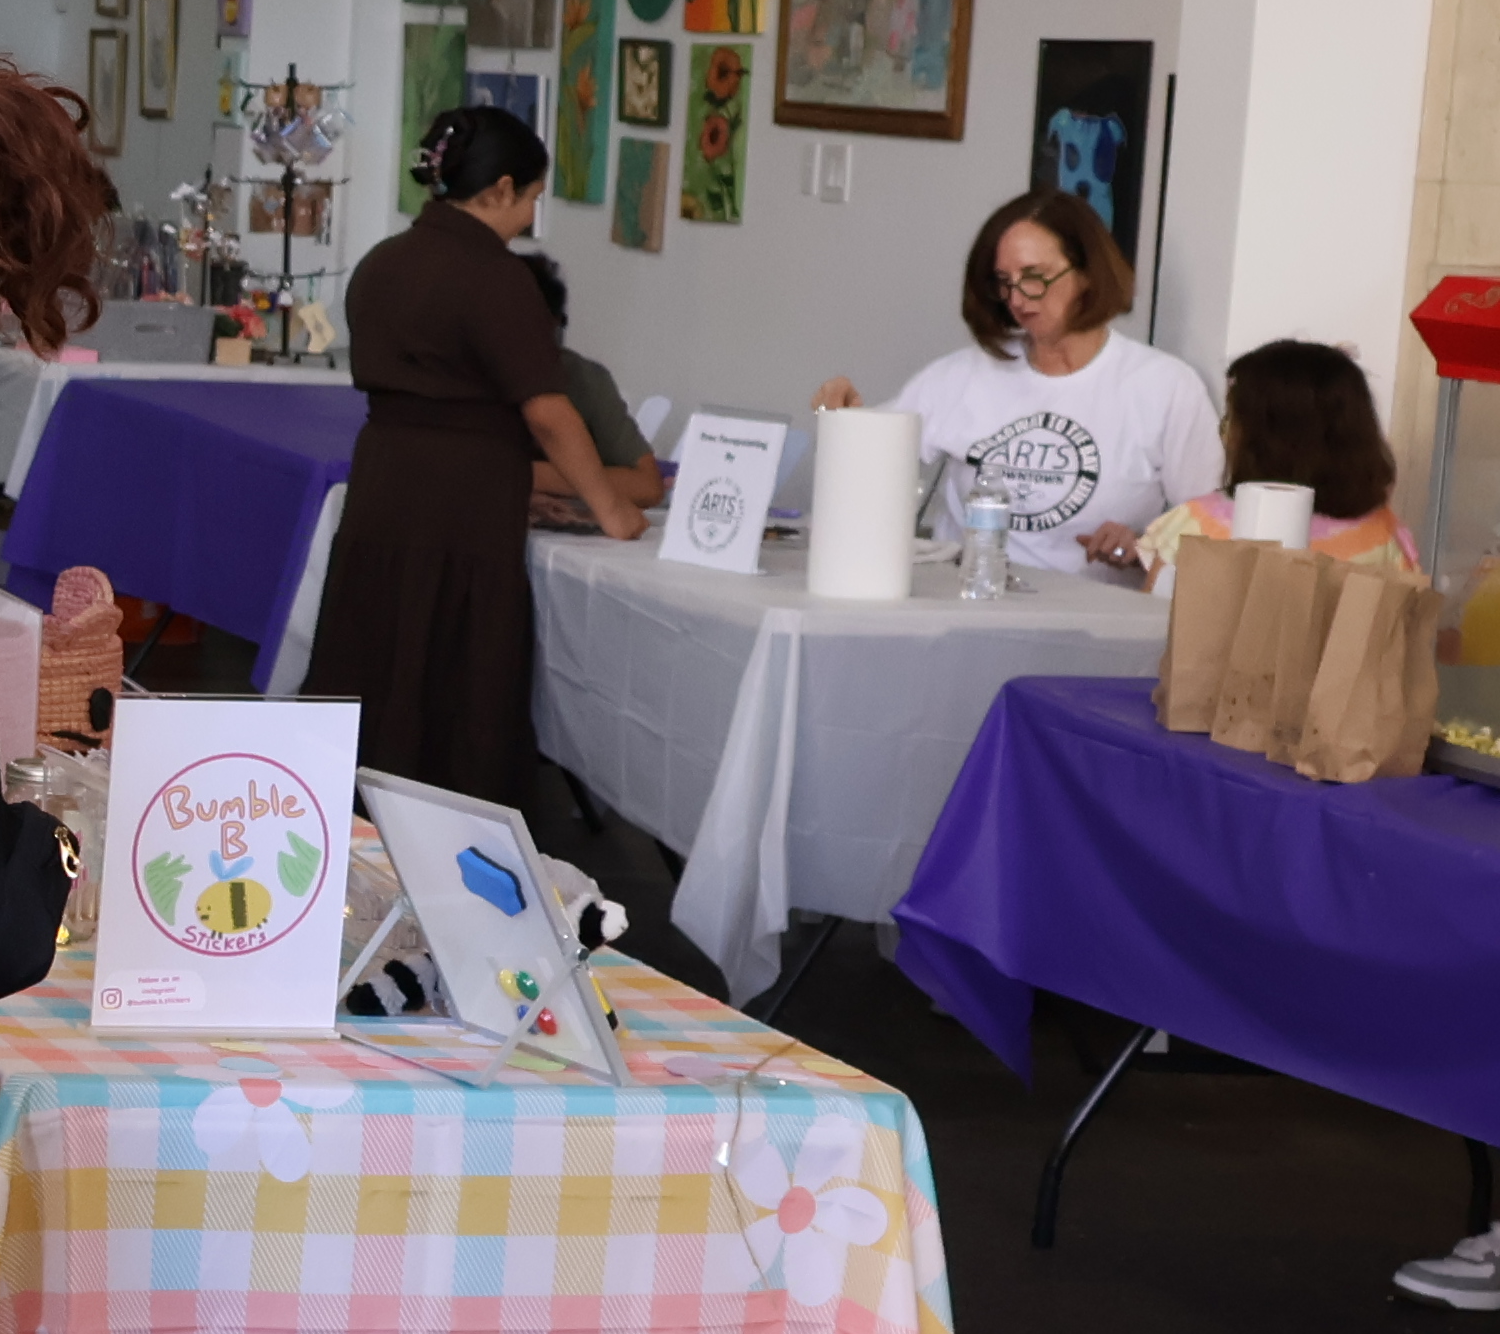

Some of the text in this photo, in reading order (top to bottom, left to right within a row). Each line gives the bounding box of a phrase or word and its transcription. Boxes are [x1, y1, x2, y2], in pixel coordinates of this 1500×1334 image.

[989, 440, 1073, 470] ARTS
[701, 492, 736, 516] ARTS
[162, 779, 306, 831] Bumble
[220, 820, 249, 861] B
